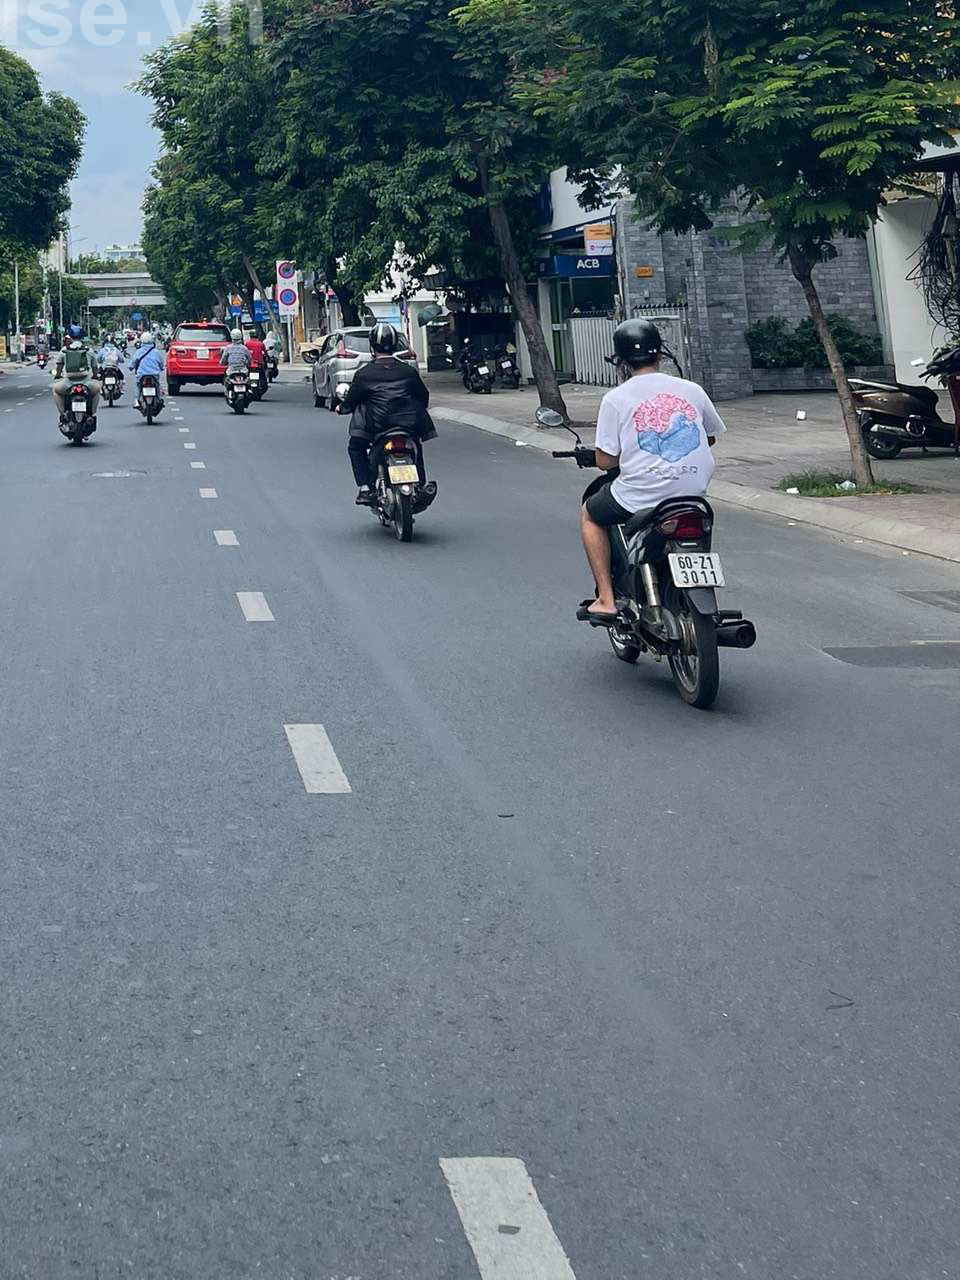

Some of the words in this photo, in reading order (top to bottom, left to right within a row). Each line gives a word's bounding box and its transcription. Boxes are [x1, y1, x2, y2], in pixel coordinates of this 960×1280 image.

[576, 258, 600, 269] ACB
[678, 555, 714, 570] 60-Z1
[681, 571, 718, 585] 3011
